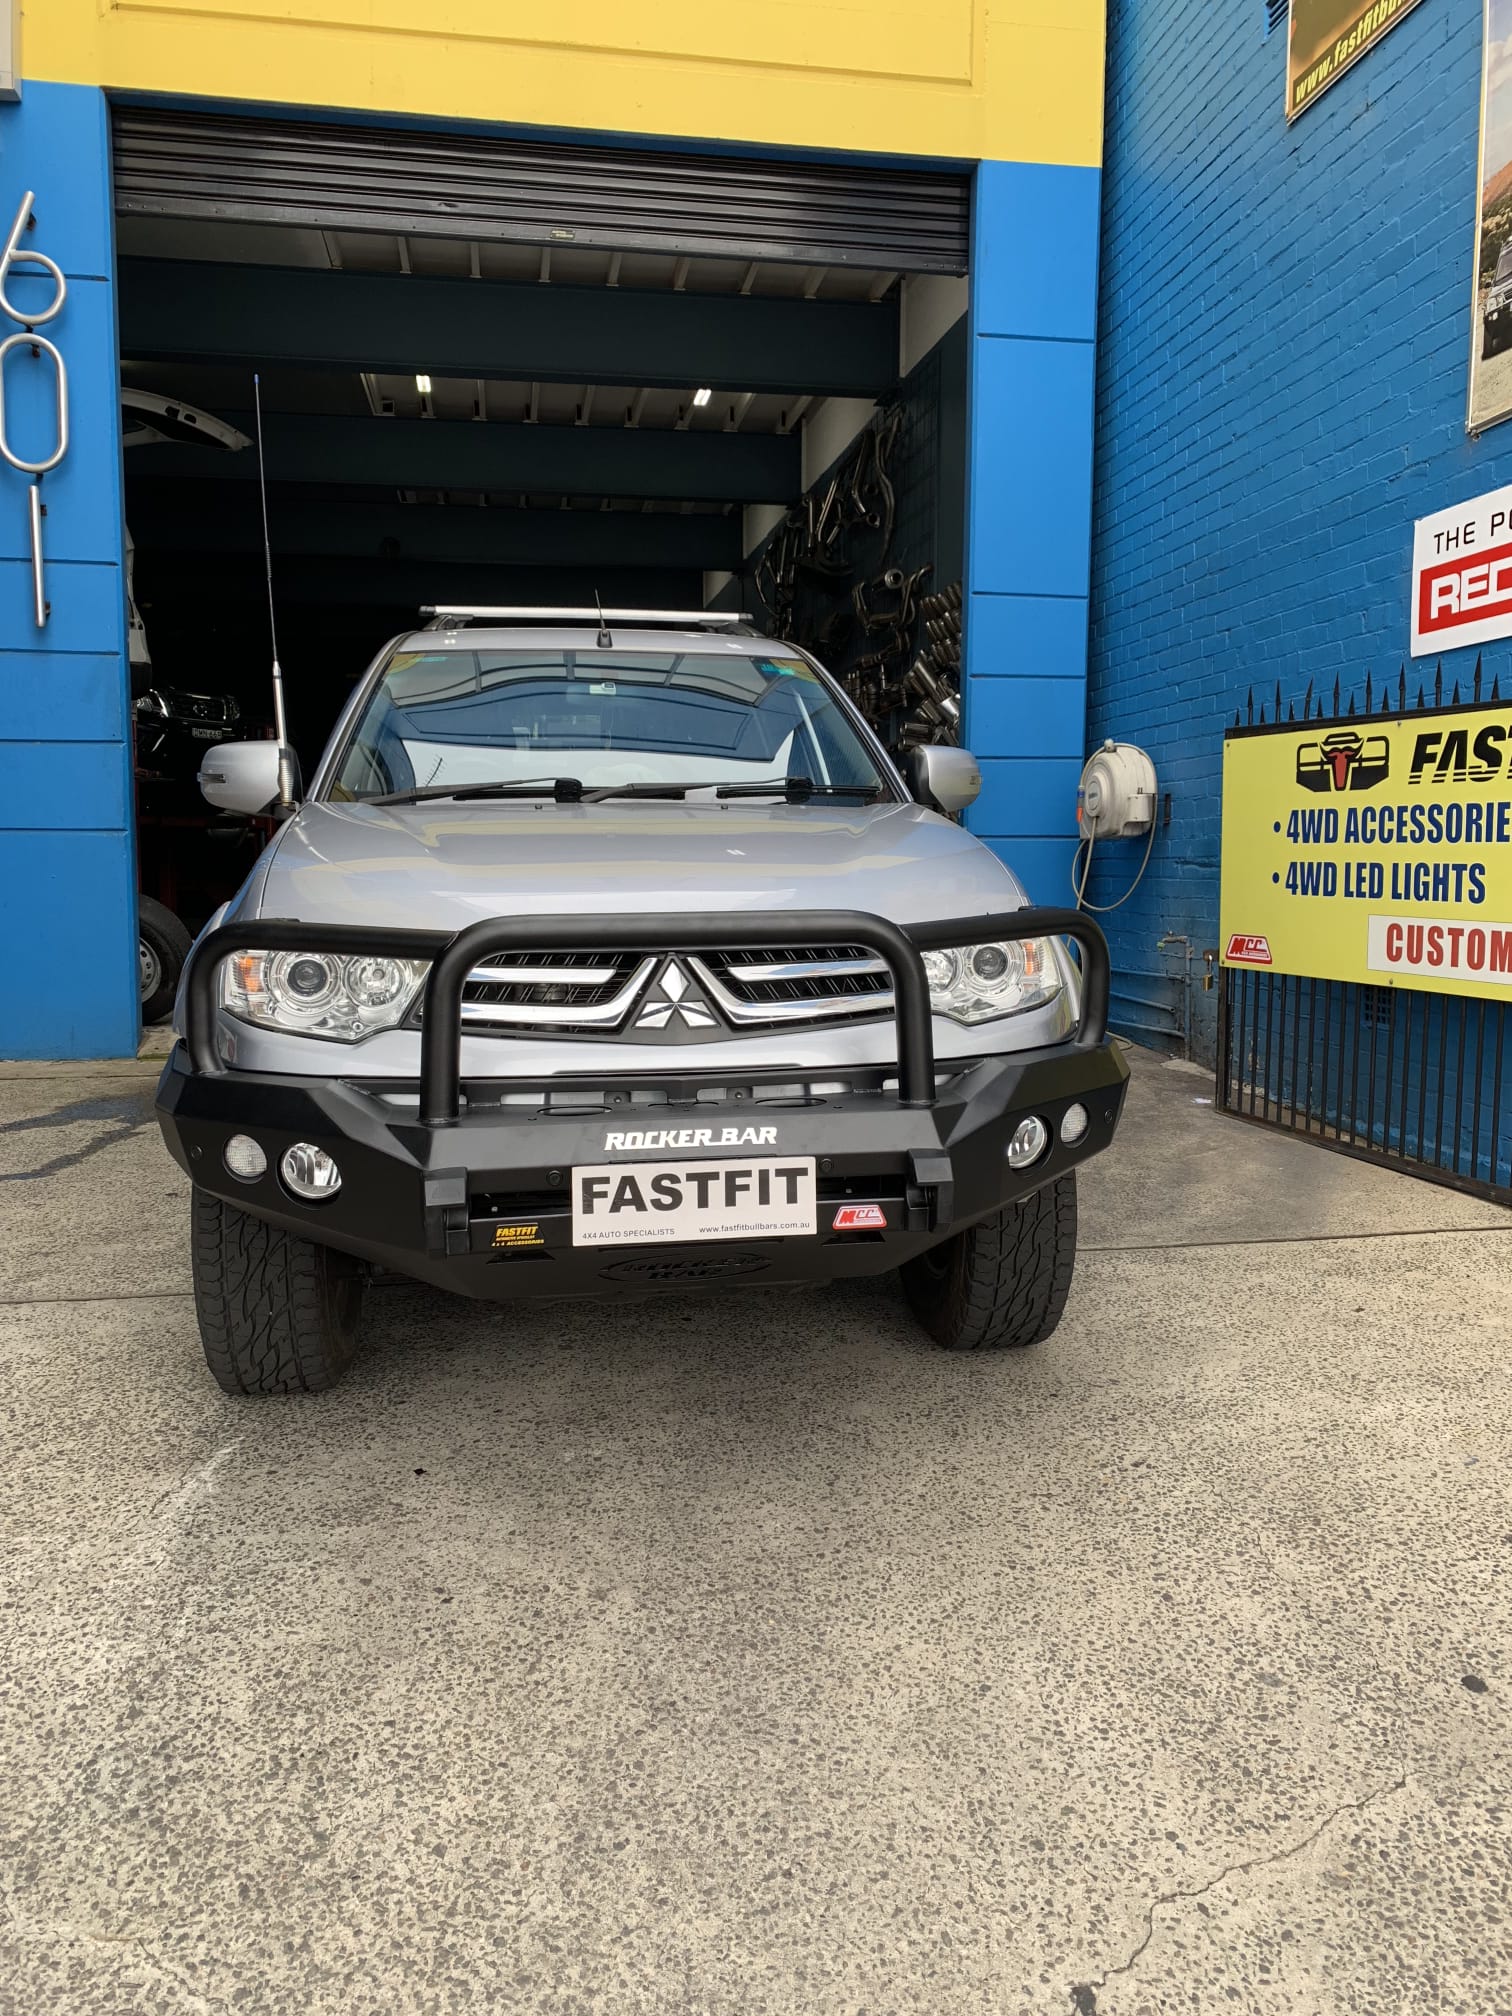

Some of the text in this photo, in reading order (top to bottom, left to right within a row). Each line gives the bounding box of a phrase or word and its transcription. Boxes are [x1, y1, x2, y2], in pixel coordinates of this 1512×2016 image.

[1296, 0, 1402, 103] www.fastfitbu
[1434, 508, 1512, 554] THE P
[1408, 724, 1512, 785] FAS
[1286, 802, 1511, 845] 4WD ACCESSORIE
[1285, 861, 1486, 904] 4WD LED LIGHTS
[1386, 923, 1512, 974] CUSTOM
[604, 1126, 778, 1151] ROCKER BAR
[581, 1167, 809, 1215] FASTFIT
[496, 1226, 539, 1237] FASTFIT
[582, 1228, 675, 1240] 4X4 AUTO SPECIALISTS
[699, 1221, 811, 1234] www.fastfitbullbars.com.au
